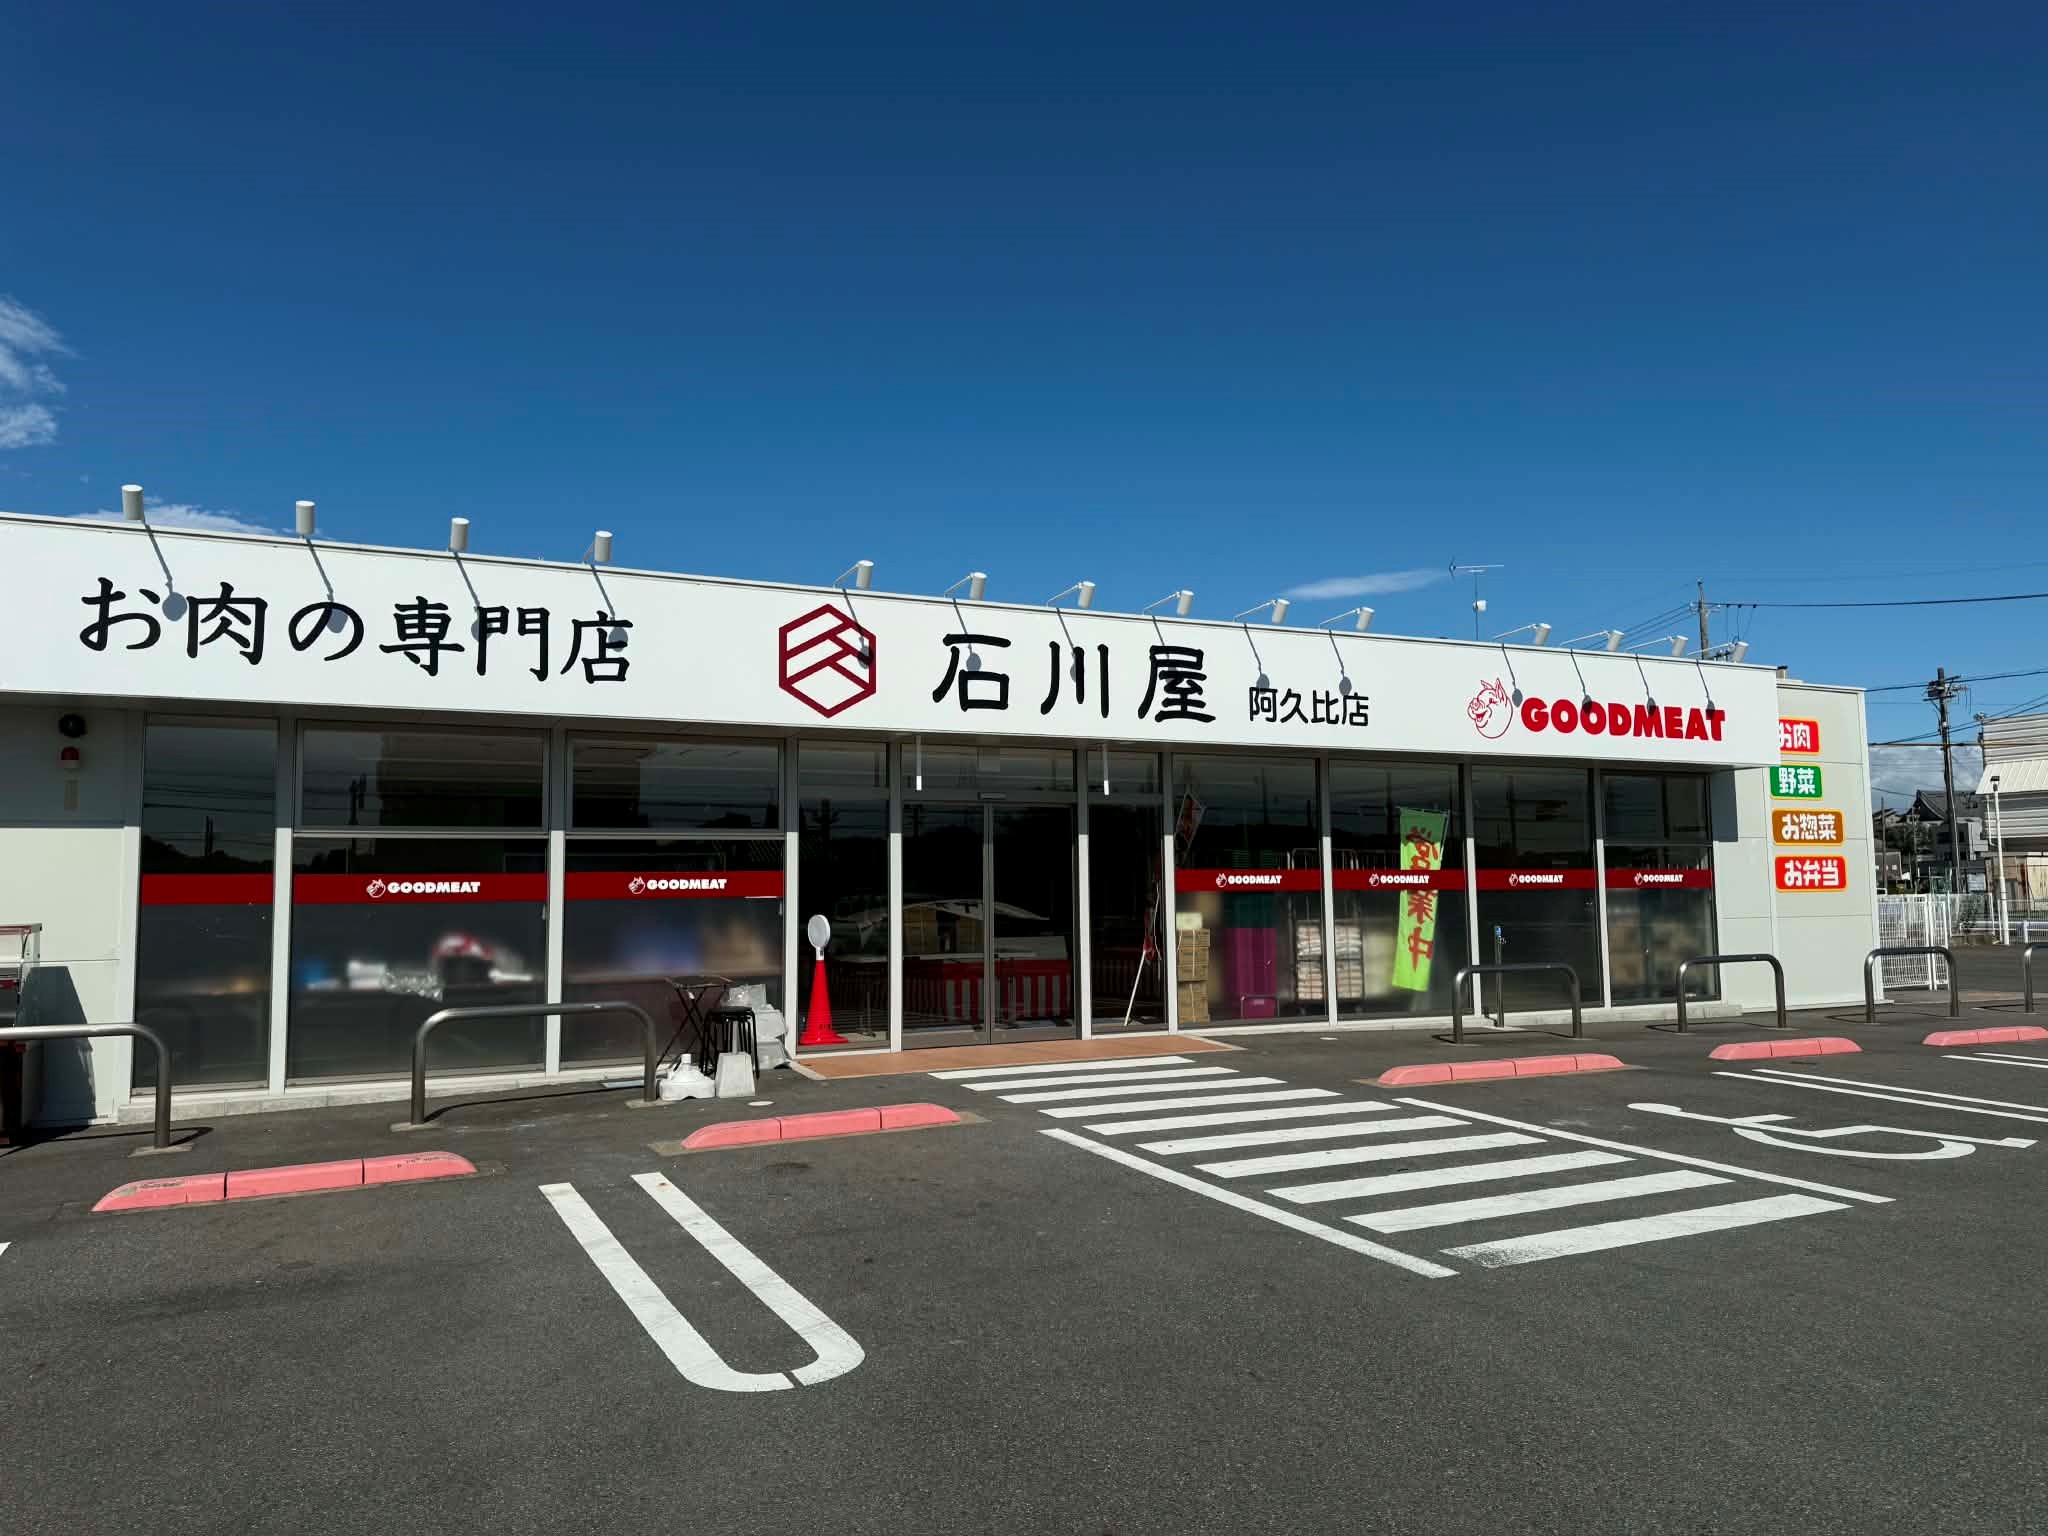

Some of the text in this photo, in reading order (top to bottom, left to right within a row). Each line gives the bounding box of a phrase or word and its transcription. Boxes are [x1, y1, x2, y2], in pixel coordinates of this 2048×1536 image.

[80, 576, 634, 684] お肉の専門店
[932, 633, 1369, 727] 石川屋 阿久比店
[1520, 697, 1726, 742] GOODMEAT
[1778, 767, 1816, 794] 野菜
[1781, 813, 1837, 841] お惣菜
[646, 878, 728, 890] GOODMEAT
[1228, 874, 1283, 885] GOODMEAT
[1380, 874, 1430, 884] GOODMEAT
[1783, 859, 1840, 887] お弁当
[387, 881, 481, 894] GOODMEAT
